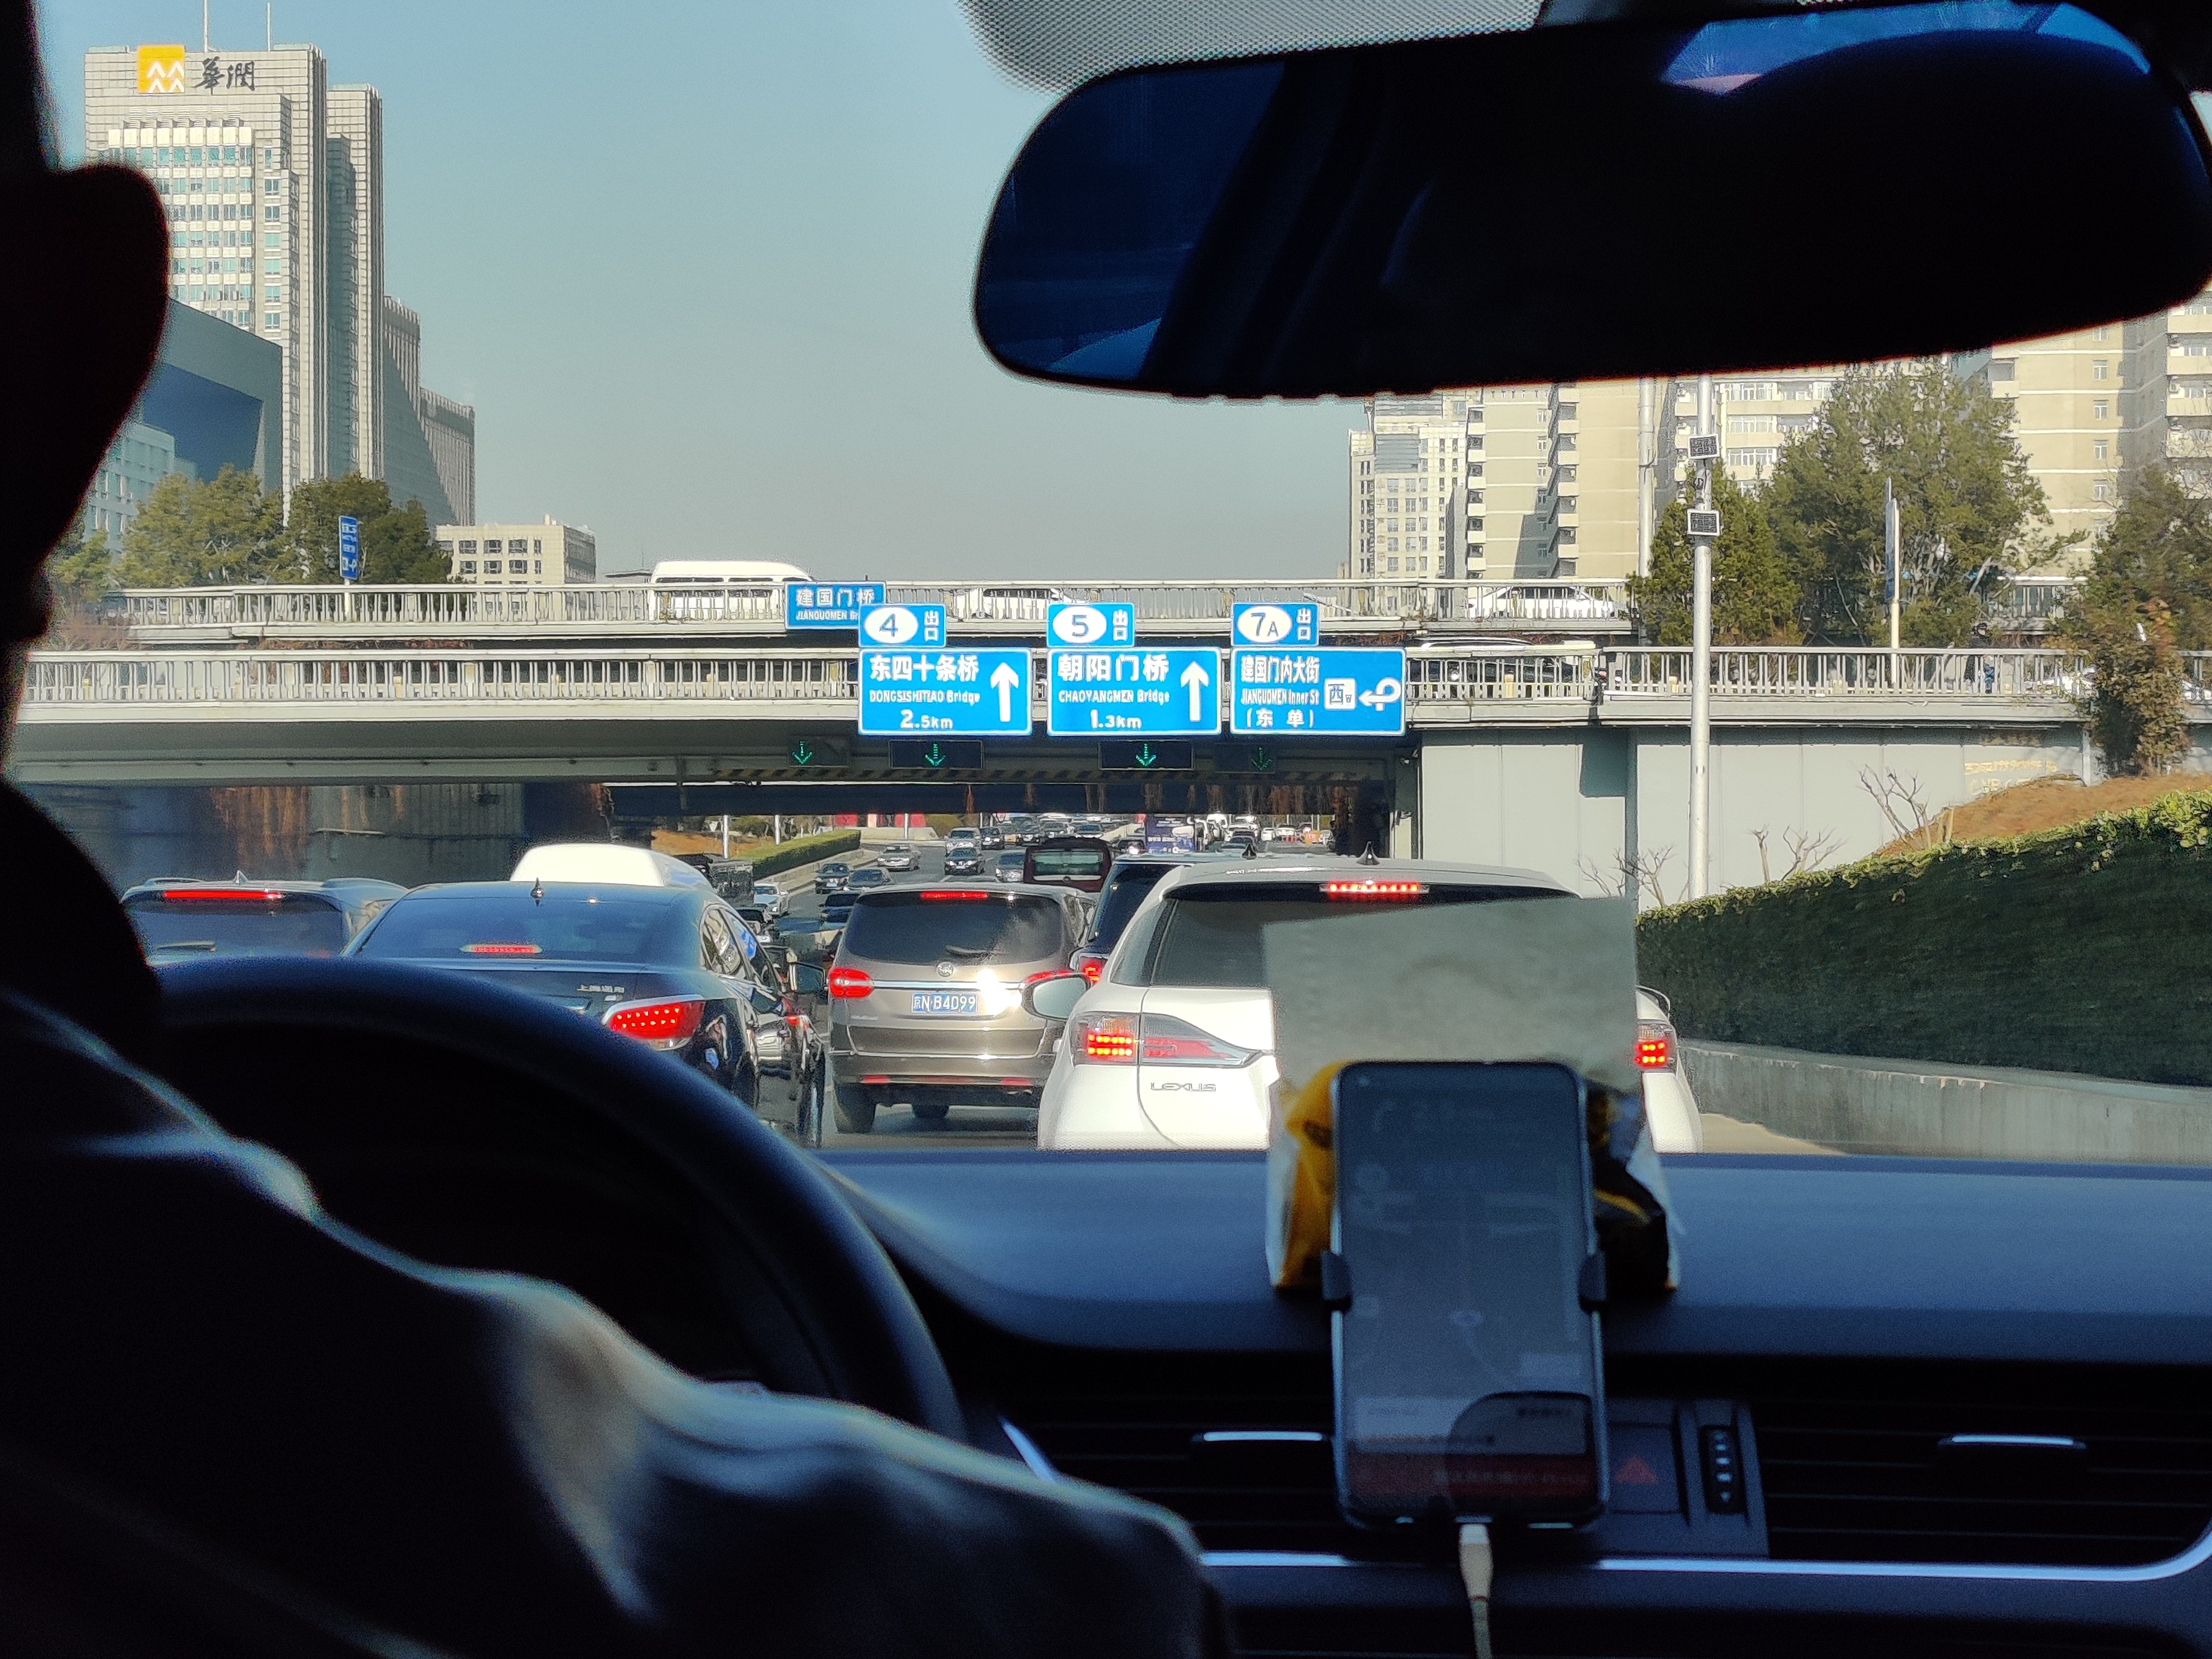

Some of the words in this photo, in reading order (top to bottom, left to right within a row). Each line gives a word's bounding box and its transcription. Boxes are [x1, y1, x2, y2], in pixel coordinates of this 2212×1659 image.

[796, 587, 874, 607] 建国门桥
[879, 613, 899, 637] 4
[924, 609, 940, 642] 出口
[1071, 614, 1090, 638] 5
[1112, 609, 1129, 642] 出口
[1250, 612, 1279, 638] 7A
[1297, 609, 1312, 641] 出口
[869, 654, 979, 682] 东四十条桥
[1057, 654, 1170, 682] 朝阳门桥
[1240, 655, 1320, 684] 建国门内大街
[947, 689, 980, 707] Bridge
[1058, 689, 1134, 703] CHAOYANGMEN
[1137, 688, 1170, 706] Bridge
[1288, 688, 1309, 706] Inner
[1310, 688, 1320, 706] St
[1328, 683, 1345, 705] 西
[900, 708, 953, 730] 2.5km
[1090, 709, 1142, 729] 1.3km
[1151, 1082, 1216, 1092] LEXUS
